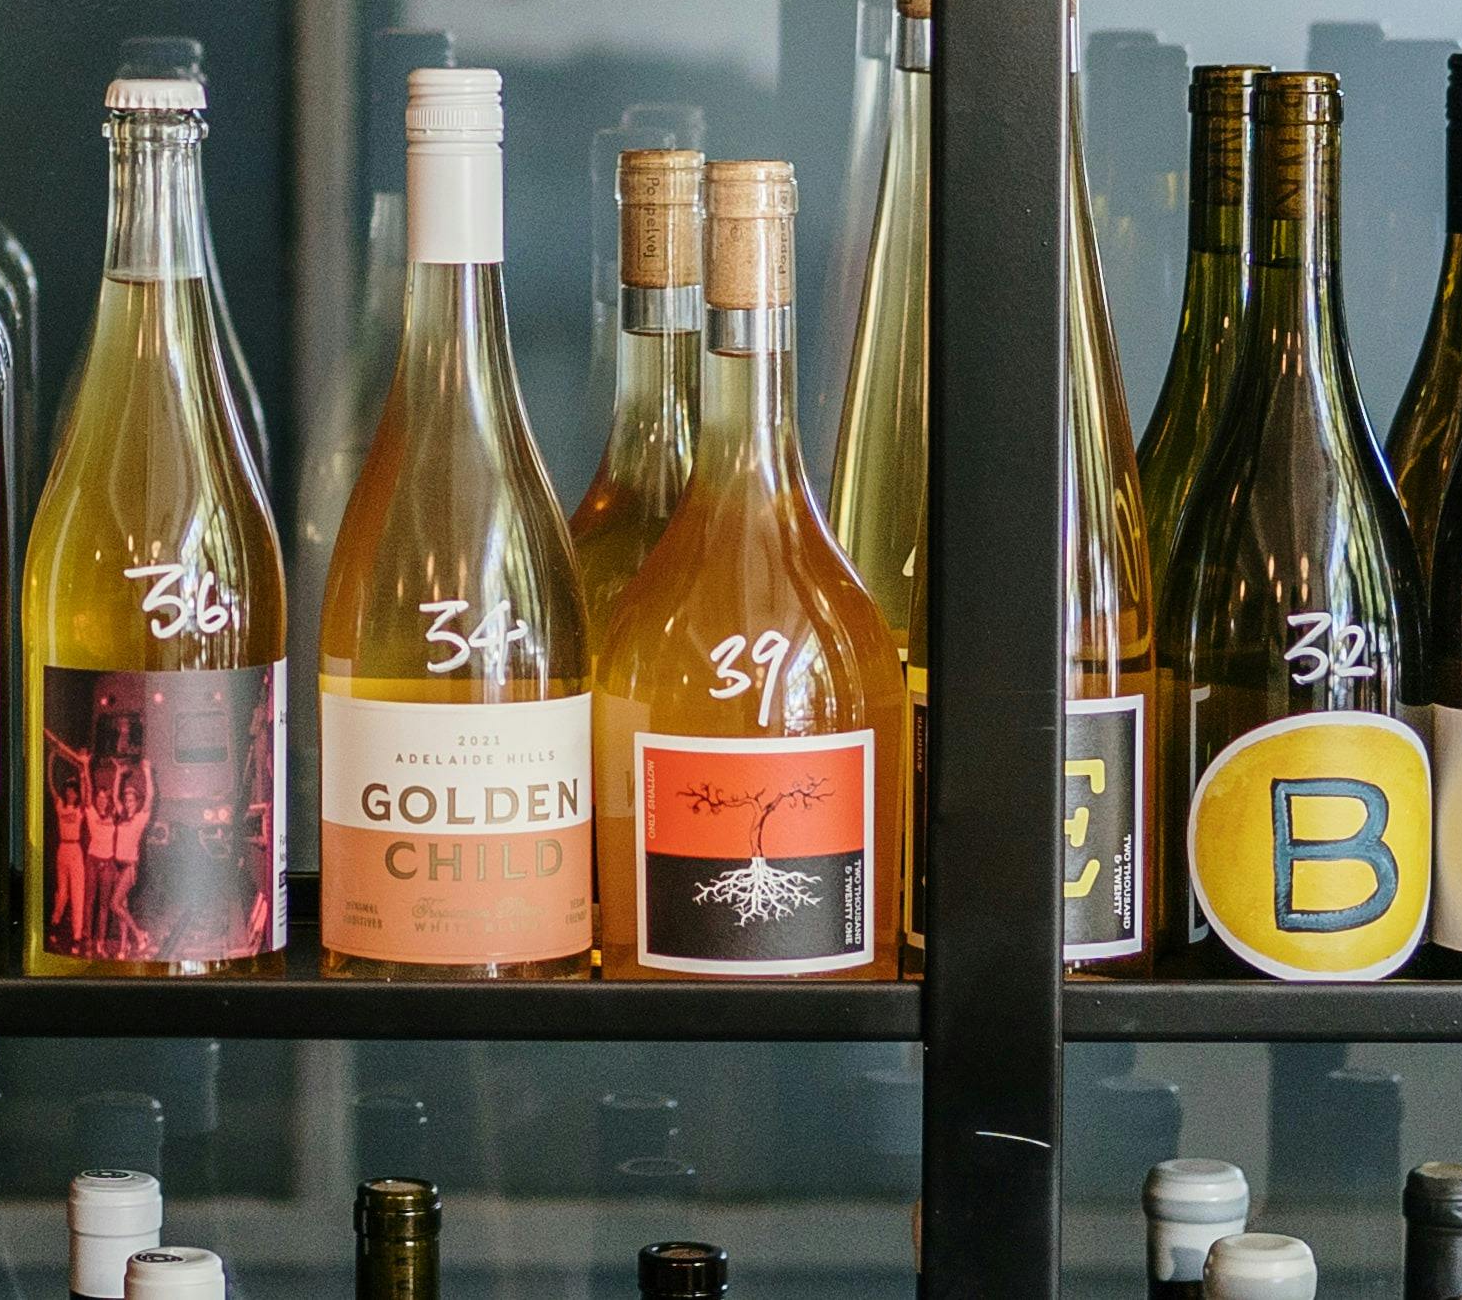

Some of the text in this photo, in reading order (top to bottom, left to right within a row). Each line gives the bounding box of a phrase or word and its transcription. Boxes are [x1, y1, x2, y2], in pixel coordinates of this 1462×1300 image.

[124, 563, 225, 640] 36
[418, 599, 528, 686] 34
[709, 629, 790, 727] 39
[1284, 612, 1374, 685] 32
[396, 750, 556, 765] ADELAIDE HILLS
[457, 735, 501, 747] 2021
[361, 778, 579, 825] GOLDEN
[384, 839, 563, 881] CHILD
[1270, 777, 1399, 934] B
